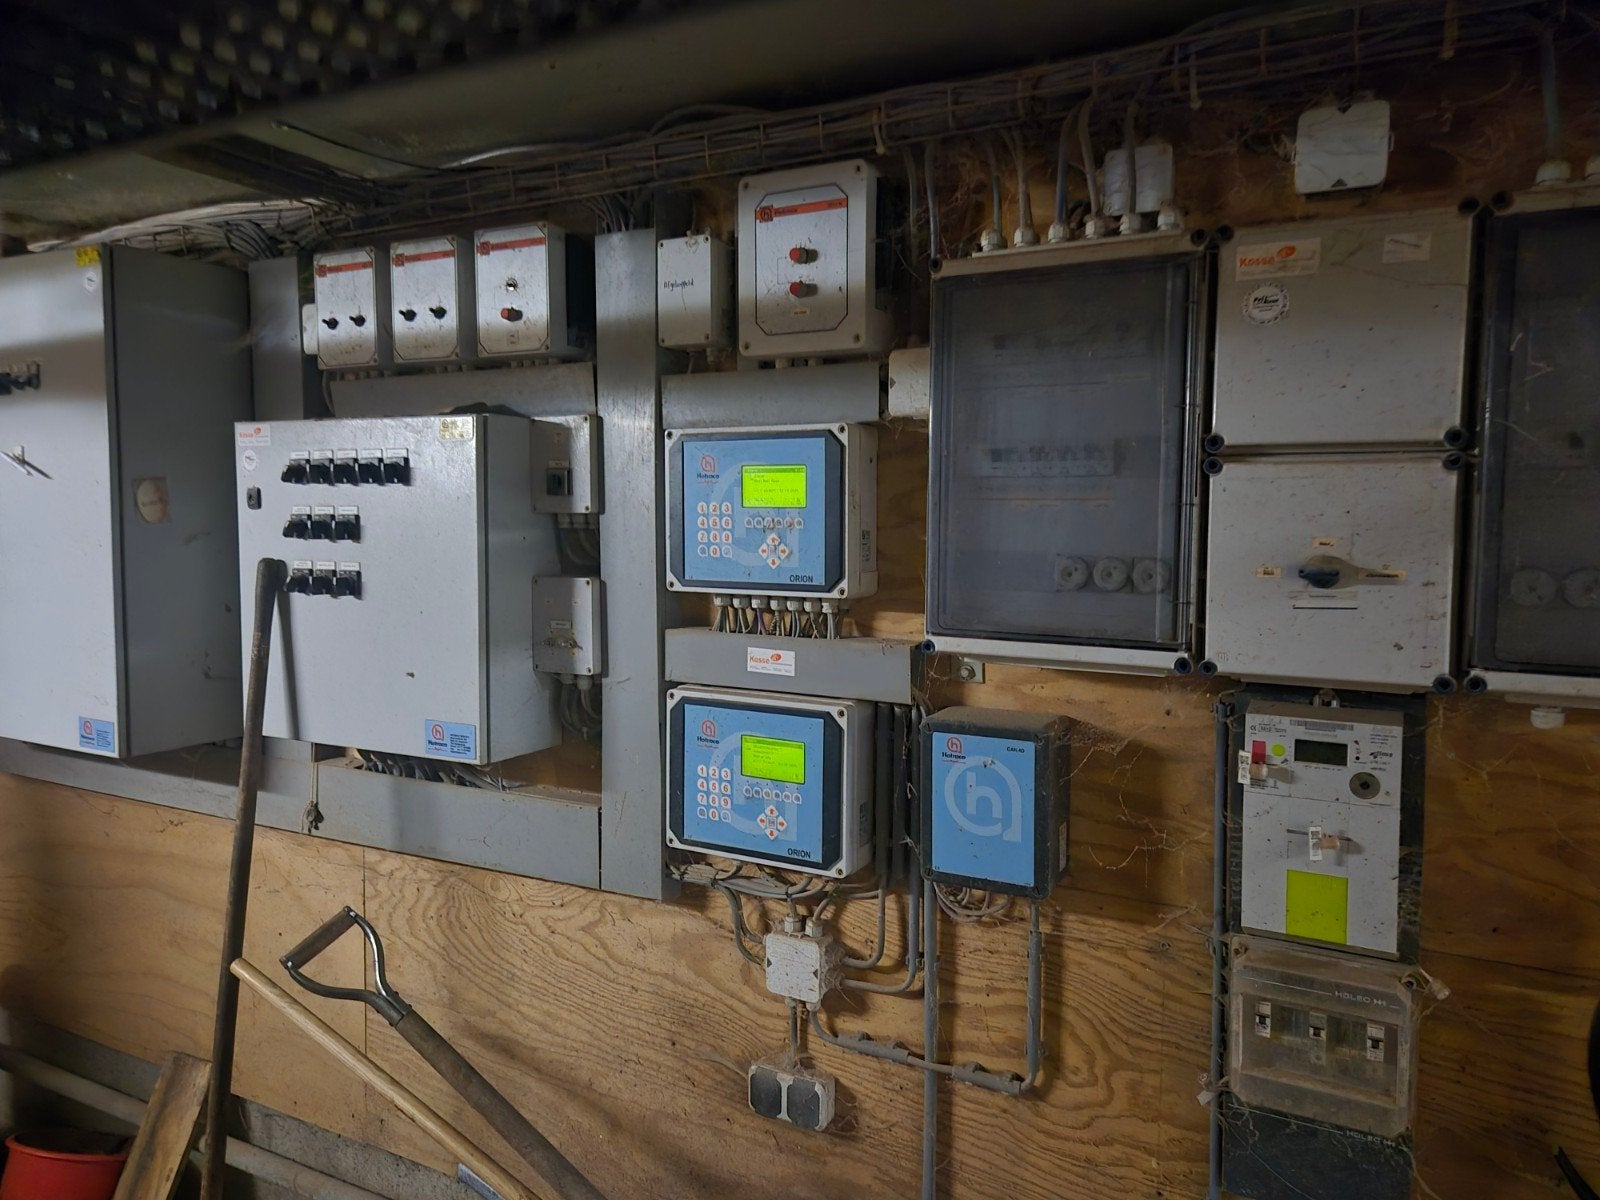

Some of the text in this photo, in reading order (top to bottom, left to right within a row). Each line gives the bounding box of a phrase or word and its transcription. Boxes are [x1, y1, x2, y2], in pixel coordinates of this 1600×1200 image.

[789, 574, 814, 583] ORION
[749, 655, 770, 665] Kosse
[787, 847, 811, 859] ORION
